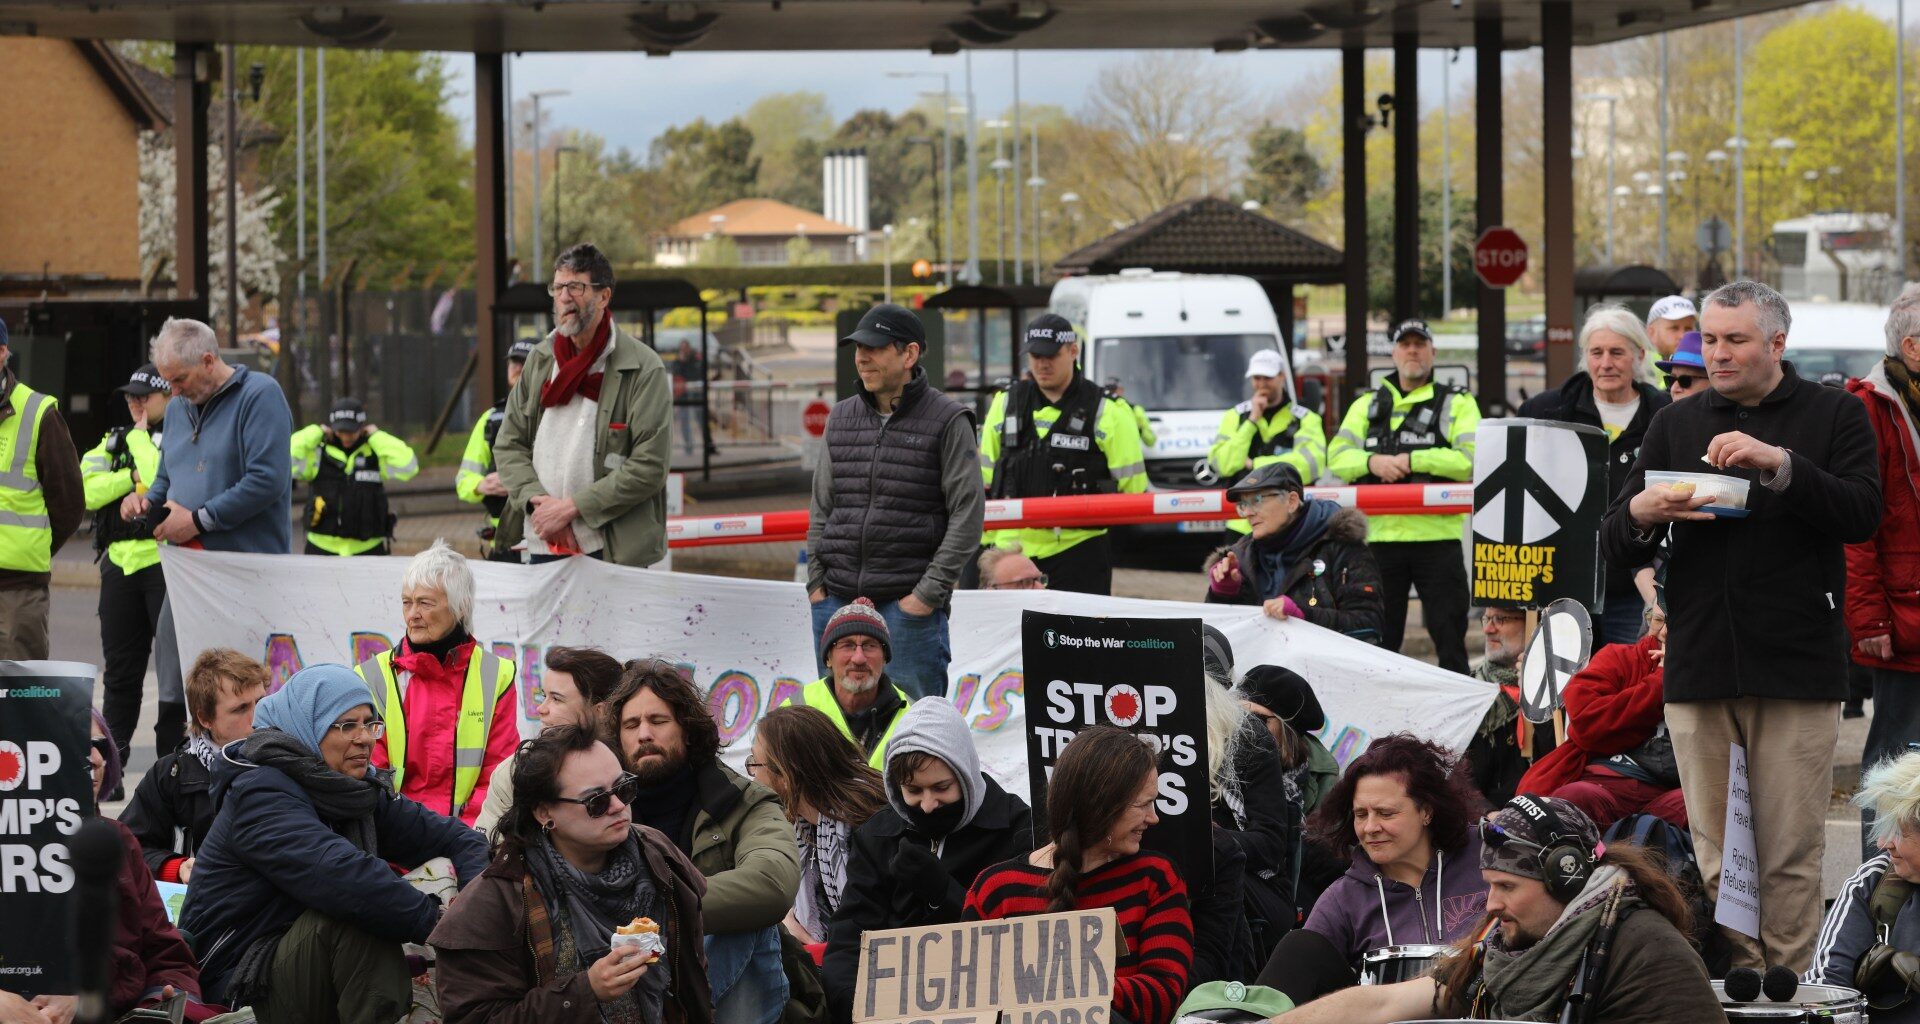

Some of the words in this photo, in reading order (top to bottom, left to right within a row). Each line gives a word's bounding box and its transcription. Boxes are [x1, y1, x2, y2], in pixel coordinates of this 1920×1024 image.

[1478, 249, 1527, 267] STOP
[1029, 328, 1053, 339] POLICE
[1053, 435, 1087, 449] POLICE
[1475, 543, 1517, 563] KICK
[1519, 546, 1556, 565] OUT
[1474, 561, 1554, 584] TRUMP'S
[1474, 580, 1533, 602] NUKES
[1060, 634, 1083, 648] Stop
[1085, 636, 1100, 648] the
[1102, 637, 1125, 648] War
[1127, 638, 1175, 649] coalition
[10, 686, 61, 698] coalition
[1046, 679, 1178, 728] STOP
[1508, 794, 1547, 821] ENTIST
[0, 843, 76, 894] RS
[1732, 847, 1748, 871] Right
[1723, 869, 1746, 893] Refuse
[864, 924, 1010, 1017] FIGHT
[1013, 915, 1109, 1004] WAR
